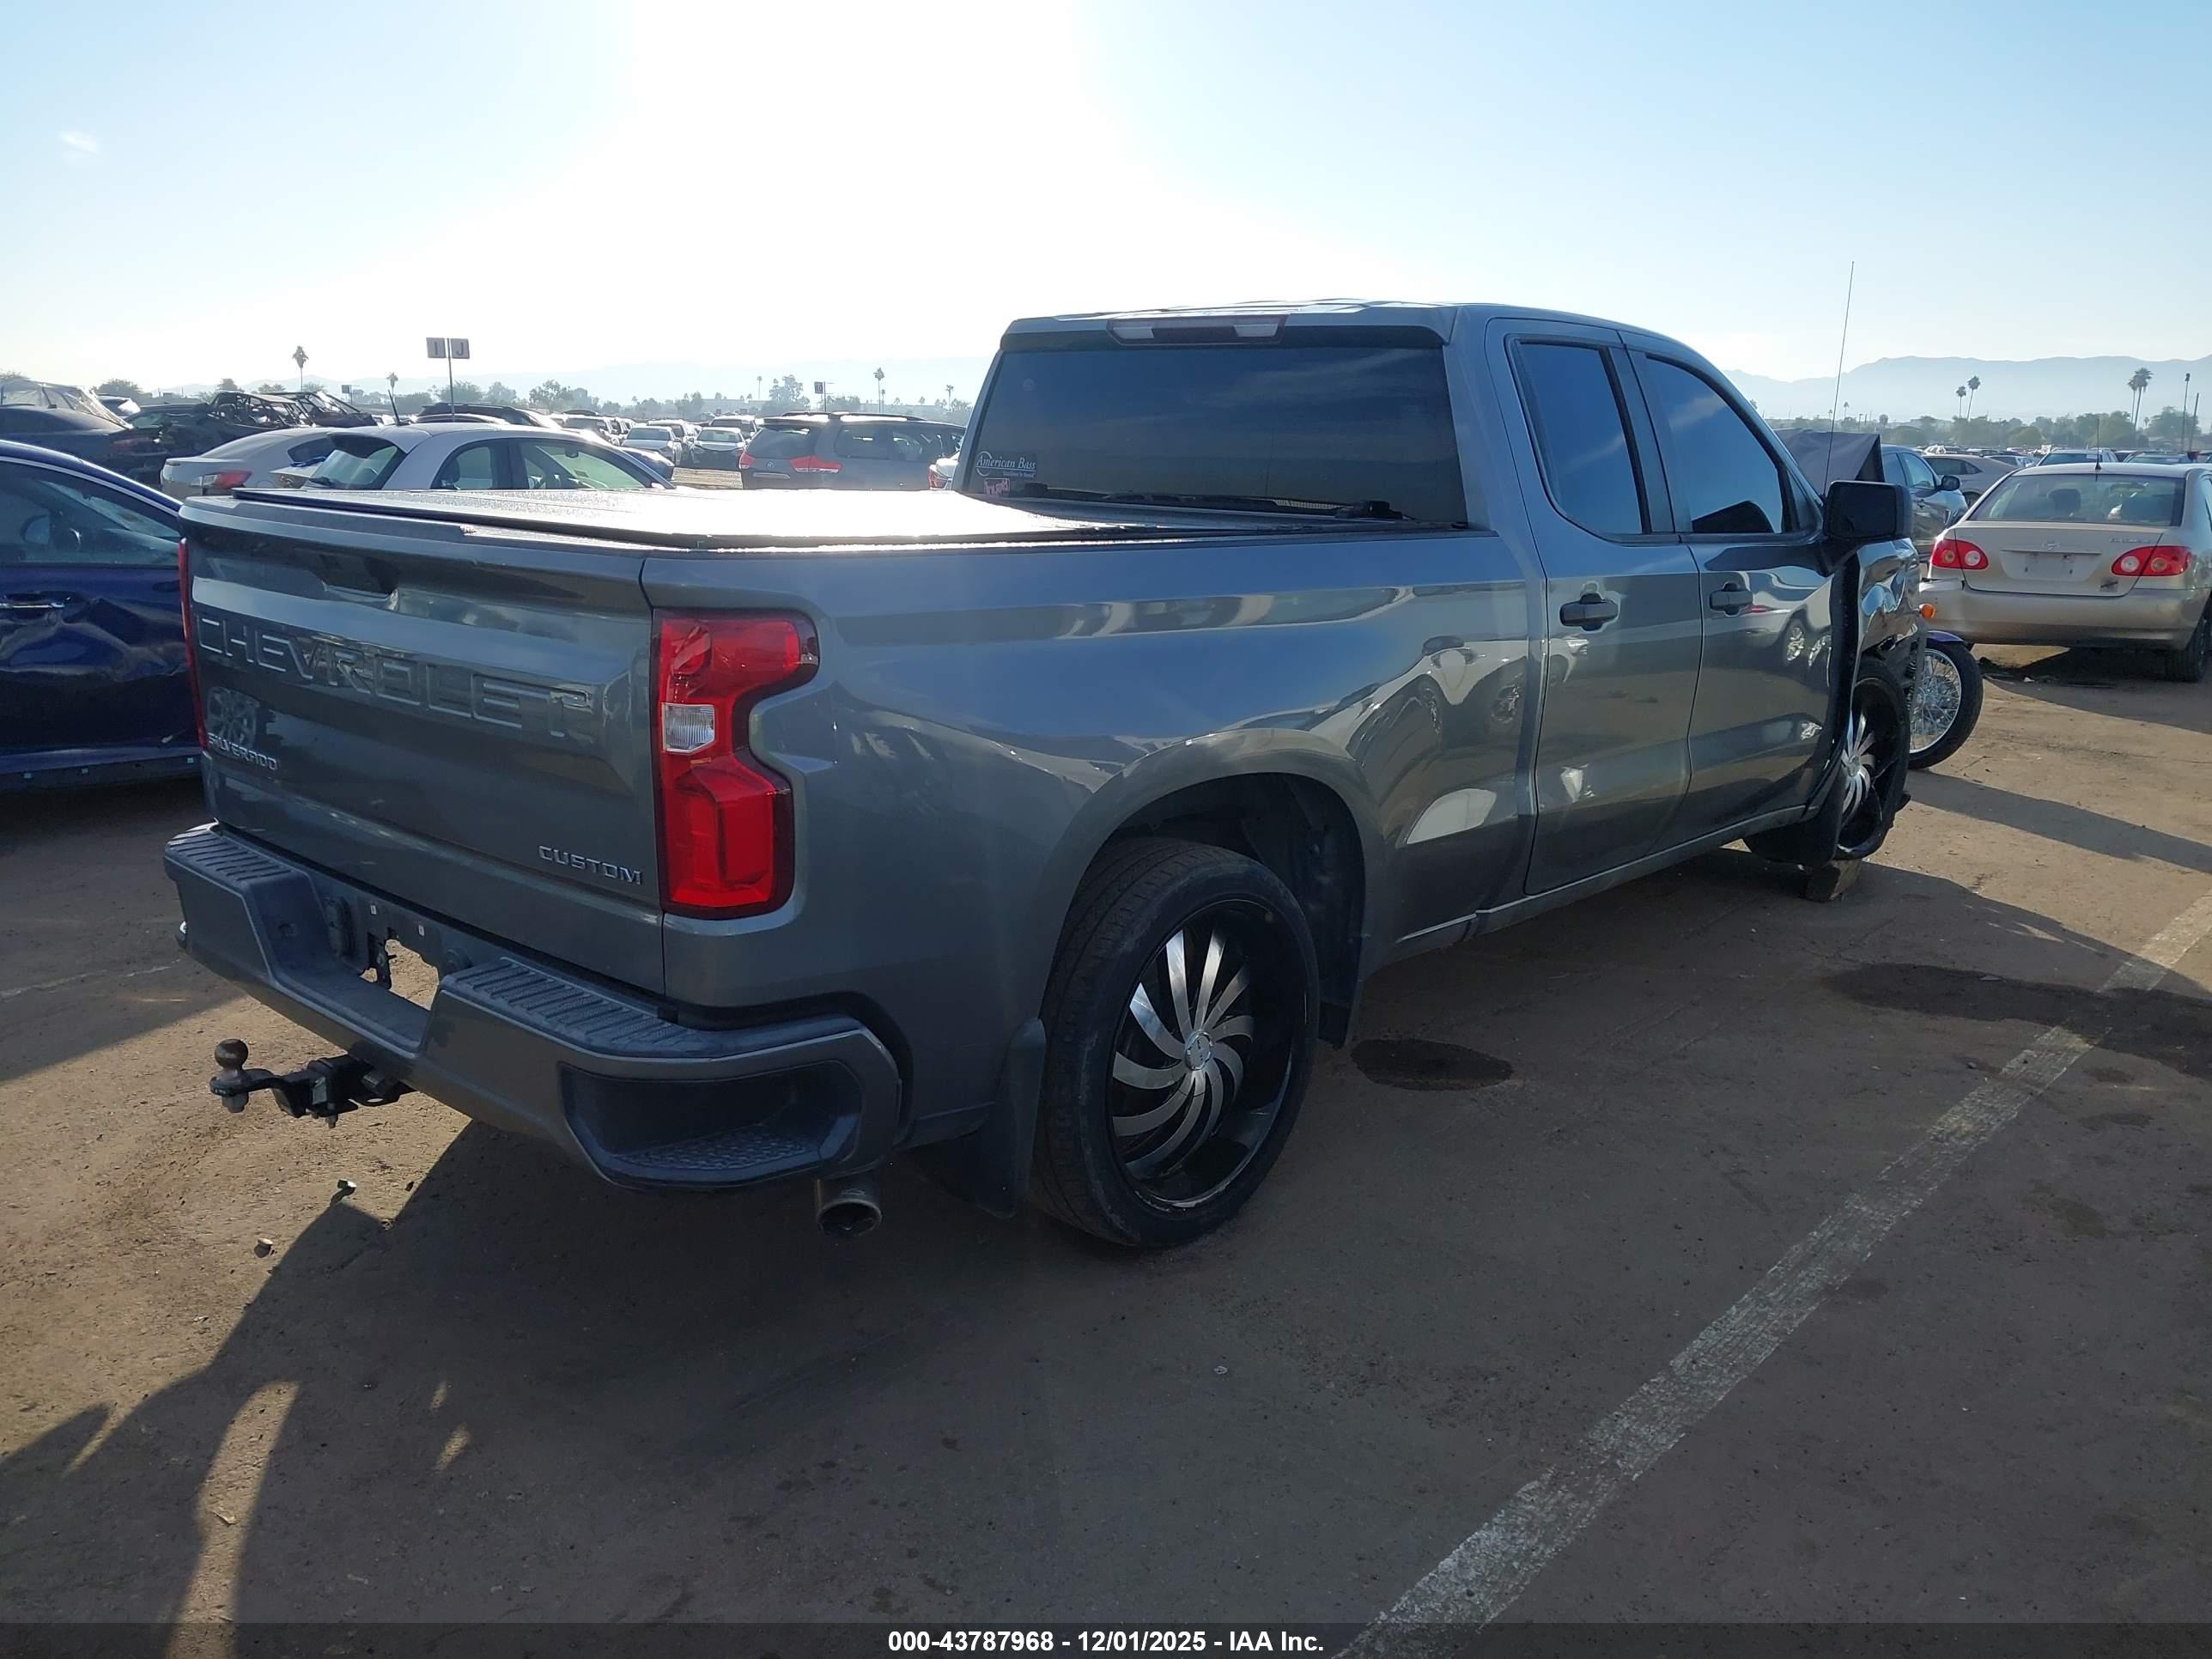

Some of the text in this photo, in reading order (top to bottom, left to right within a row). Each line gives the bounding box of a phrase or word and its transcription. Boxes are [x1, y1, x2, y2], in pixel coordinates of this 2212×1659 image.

[456, 342, 464, 356] J
[976, 454, 1036, 470] American Bass
[197, 614, 592, 738] CHEVROLET
[207, 732, 278, 770] SILVERADO
[538, 845, 642, 885] CUSTOM
